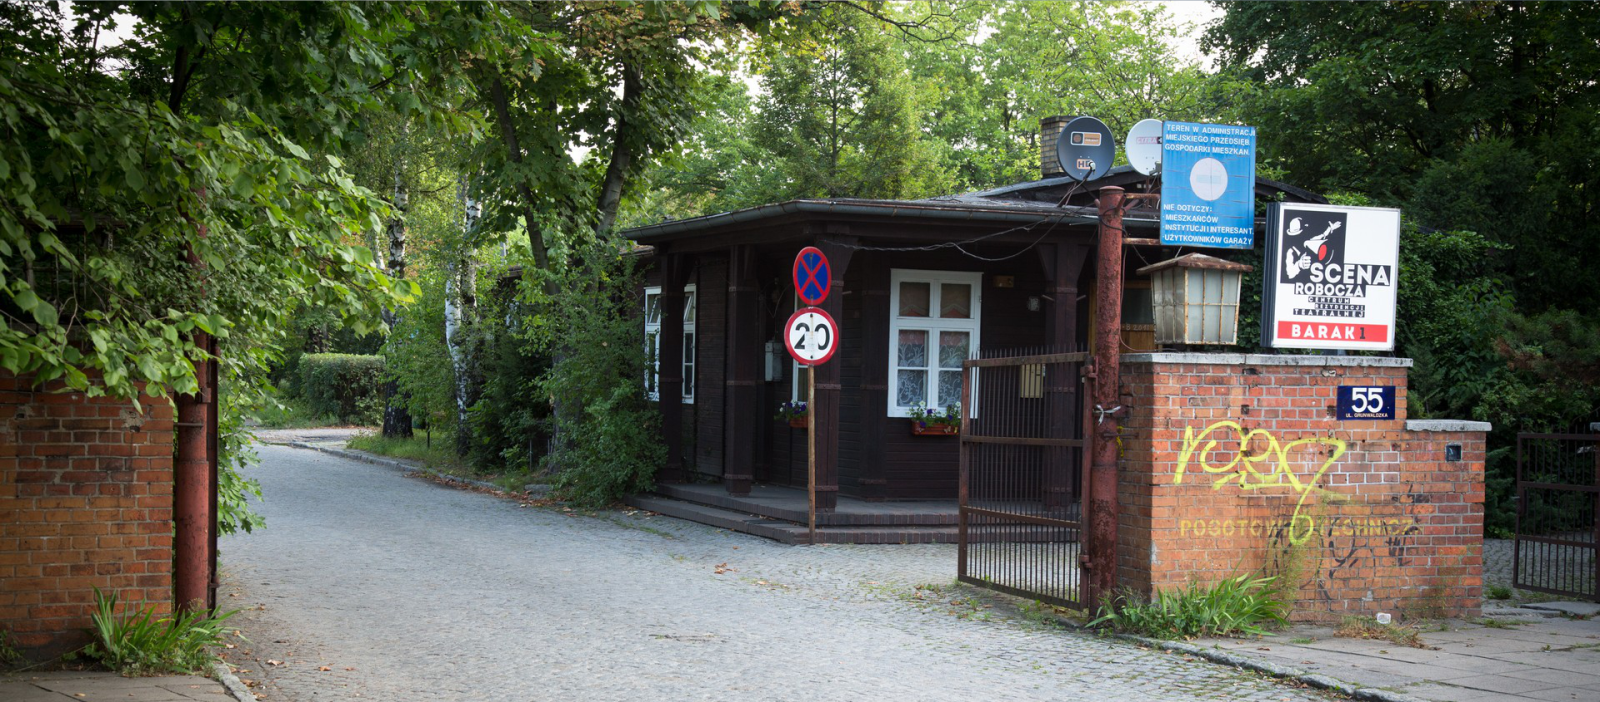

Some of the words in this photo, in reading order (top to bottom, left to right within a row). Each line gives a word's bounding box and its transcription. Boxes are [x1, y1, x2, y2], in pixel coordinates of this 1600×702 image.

[1166, 124, 1190, 132] TEREN
[1165, 134, 1209, 143] MIEJSKIEGO
[1164, 143, 1211, 153] GOSPODARKI
[1163, 203, 1174, 211] NIE
[1177, 204, 1213, 212] DOTYCZY:
[1165, 213, 1219, 223] MIESZKAŃCÓW
[1165, 224, 1206, 233] INSTYTUCJI
[1164, 233, 1222, 243] UŻYTKOWNIKÓW
[1223, 235, 1252, 245] GARAŻY
[1310, 262, 1390, 285] SCENA
[1295, 282, 1364, 297] ROBOCZA
[1308, 296, 1350, 304] CENTRUM
[1294, 308, 1364, 317] TEATRALNEJ
[794, 322, 830, 350] 20
[1291, 324, 1355, 339] BARAK
[1359, 327, 1366, 339] 1
[1351, 387, 1384, 413] 55
